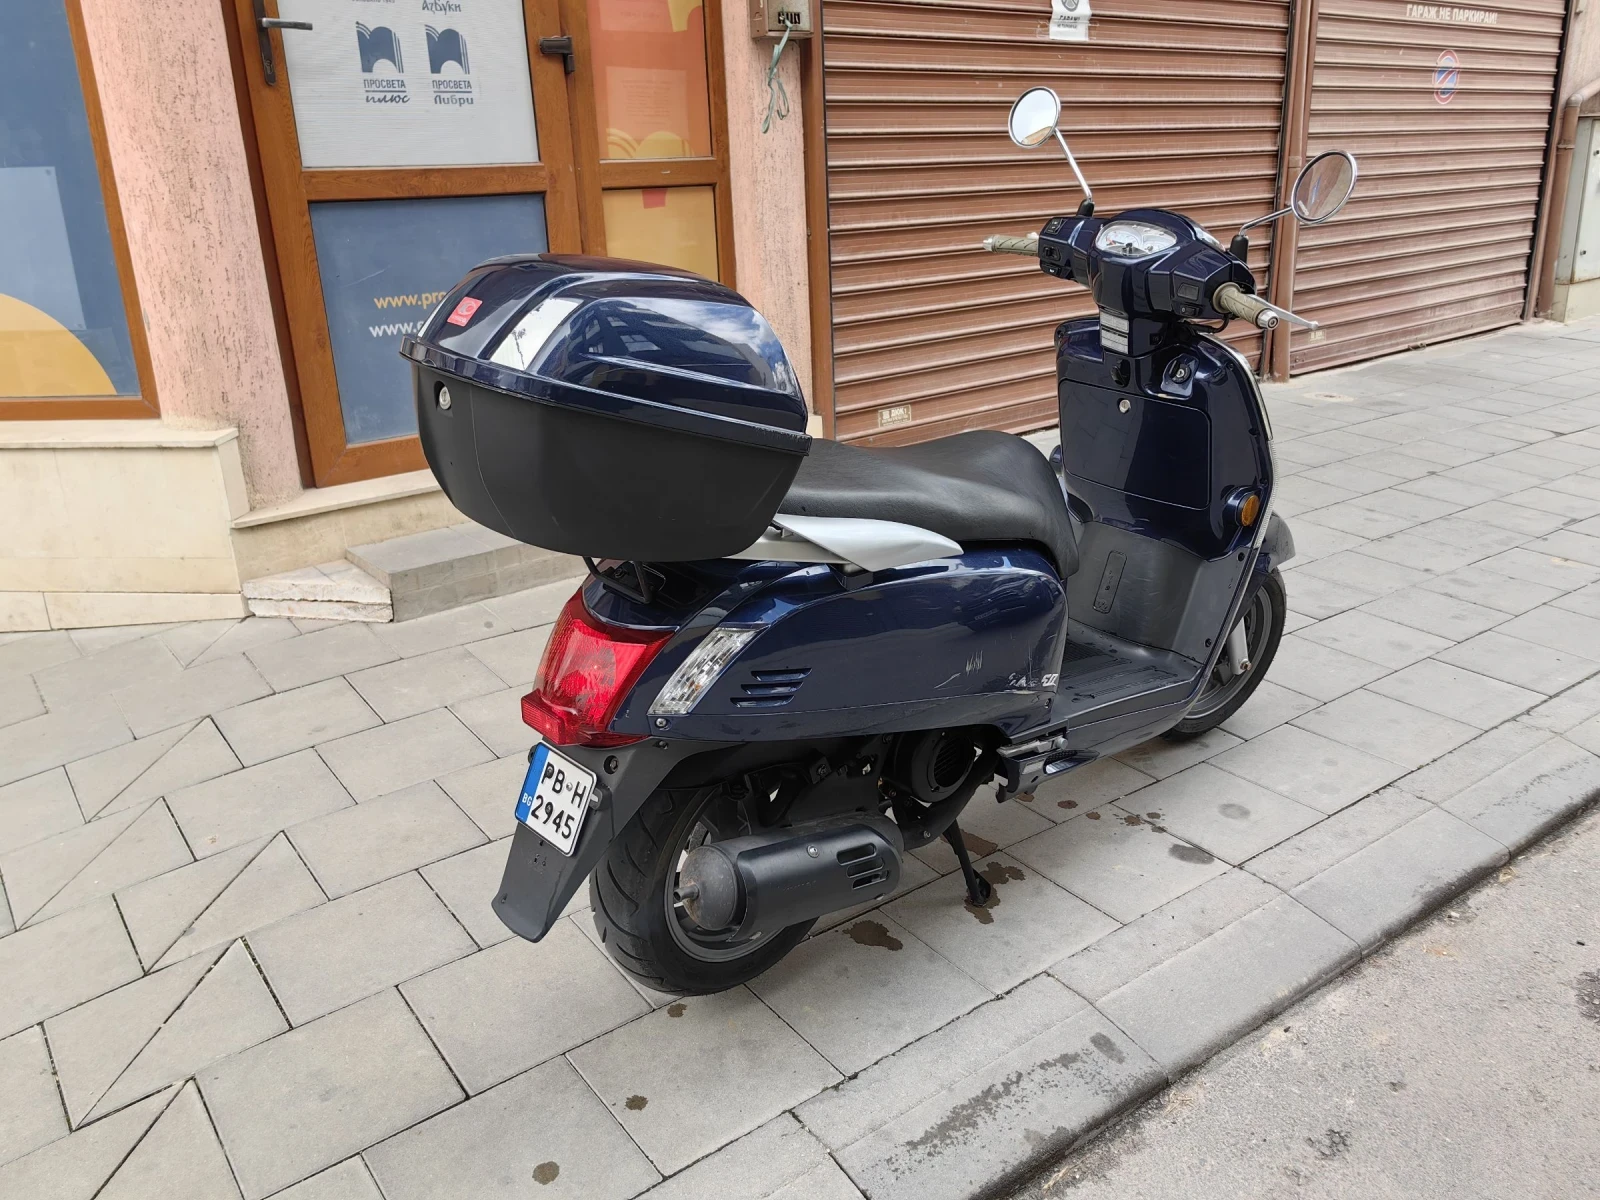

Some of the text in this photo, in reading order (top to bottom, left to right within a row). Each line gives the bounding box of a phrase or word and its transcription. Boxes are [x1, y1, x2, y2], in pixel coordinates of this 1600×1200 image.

[1406, 4, 1437, 19] ГАРАЖ
[1439, 7, 1451, 20] НЕ
[363, 78, 406, 89] ПРОСВЕТА
[432, 80, 472, 90] ПРОСВЕТА
[365, 94, 410, 104] плюс
[434, 95, 474, 107] Либри
[522, 792, 533, 807] BG
[531, 794, 575, 839] 2945
